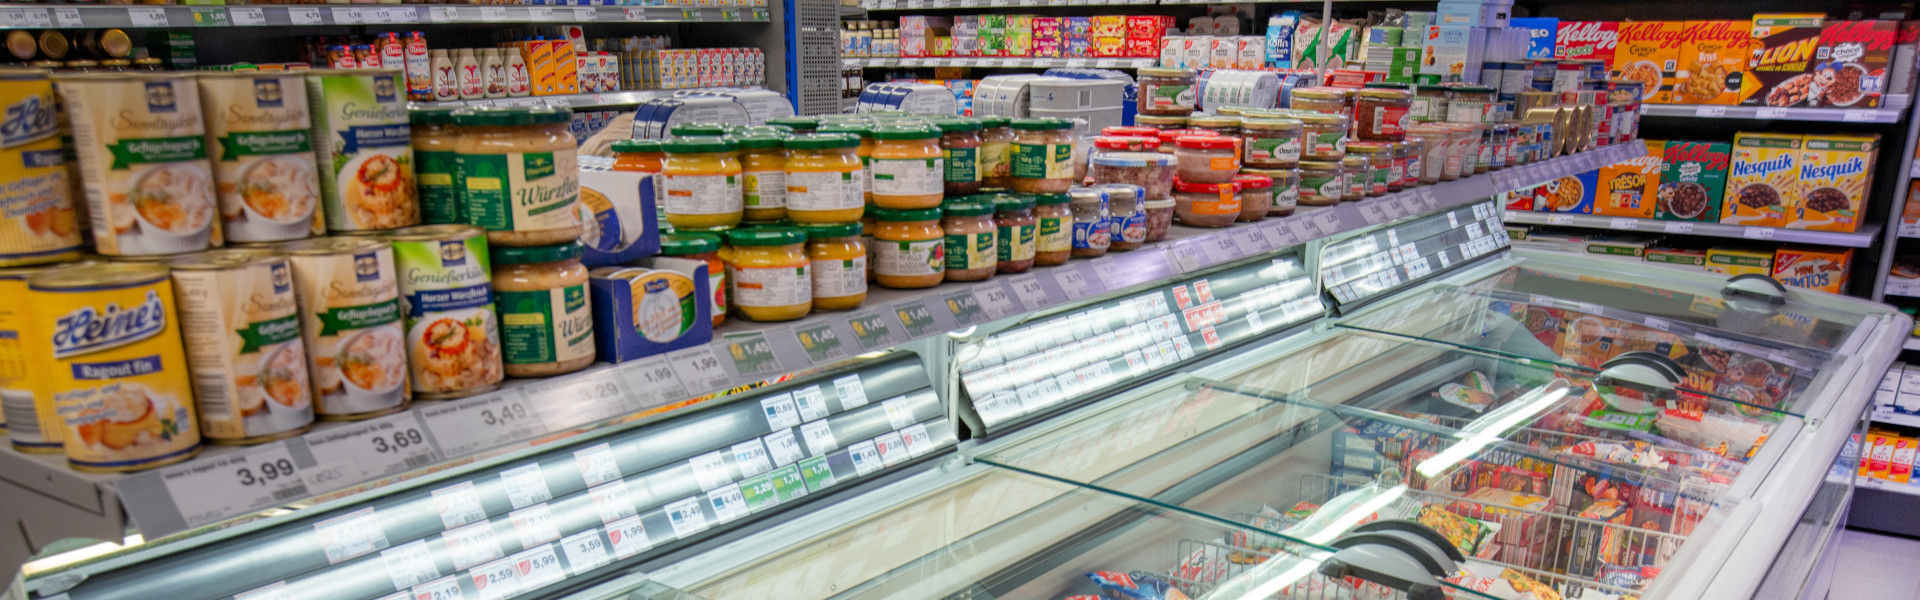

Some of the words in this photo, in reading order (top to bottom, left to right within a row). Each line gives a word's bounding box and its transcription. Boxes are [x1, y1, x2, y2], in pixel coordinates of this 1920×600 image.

[1760, 36, 1820, 64] LION
[1733, 154, 1793, 178] Nesquik
[1800, 157, 1863, 181] Nesquik
[1609, 173, 1647, 190] TRÊSOR
[1794, 264, 1814, 277] MINI
[1780, 272, 1830, 288] ZIMTOS
[54, 291, 164, 346] Heine's
[908, 305, 931, 320] 1,45
[862, 317, 885, 333] 1,45
[811, 328, 836, 345] 1,45
[82, 363, 132, 380] Ragout
[135, 359, 153, 373] fin
[691, 355, 719, 373] 1,99
[643, 366, 673, 384] 1,99
[578, 380, 619, 403] 3,29
[480, 402, 526, 426] 3,49
[774, 402, 794, 414] 0,69
[371, 427, 423, 454] 3,69
[746, 447, 765, 461] 2,99
[235, 458, 295, 487] 3,99
[811, 462, 829, 475] 1,79
[781, 471, 802, 486] 1,79
[723, 492, 743, 505] 4,49
[681, 504, 701, 518] 2,49
[622, 524, 644, 540] 1,99
[578, 538, 602, 554] 3,59
[531, 553, 557, 571] 5,99
[489, 568, 514, 585] 2,59
[433, 585, 460, 600] 2,19
